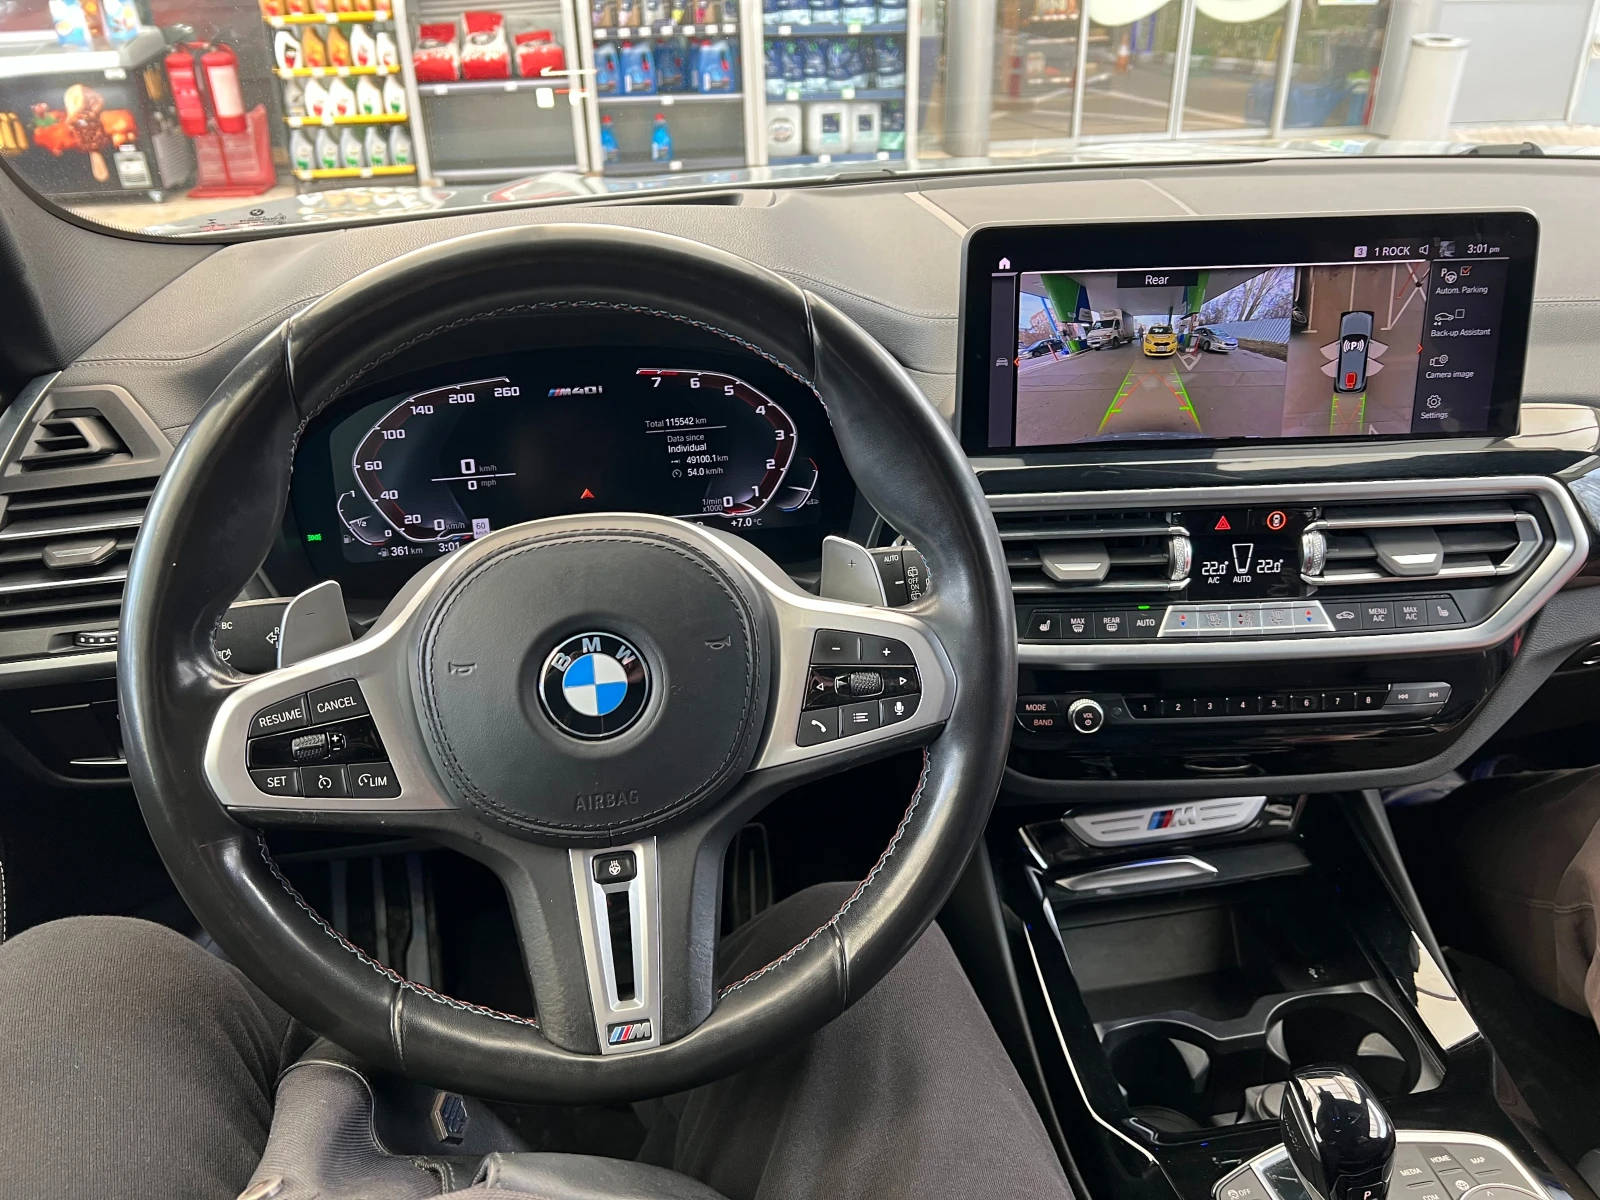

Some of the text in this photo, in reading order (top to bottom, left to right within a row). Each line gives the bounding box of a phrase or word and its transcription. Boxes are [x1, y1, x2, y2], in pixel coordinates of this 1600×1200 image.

[1358, 248, 1364, 256] 3
[1382, 246, 1410, 256] ROCK
[1467, 244, 1488, 254] 3:01
[1145, 275, 1170, 285] Rear
[1435, 286, 1488, 295] Autom. Parking
[1430, 328, 1491, 338] Back-up Assistant
[1452, 370, 1474, 378] image
[651, 377, 662, 388] 7
[690, 378, 700, 389] 6
[494, 386, 520, 398] 260
[559, 385, 602, 396] M40i
[724, 385, 734, 396] 5
[448, 393, 476, 404] 200
[410, 405, 434, 416] 140
[755, 405, 766, 416] 4
[1420, 412, 1448, 420] Settings
[645, 420, 664, 428] Total
[665, 416, 694, 426] 115542
[382, 429, 406, 440] 100
[667, 434, 704, 443] Data since
[774, 430, 785, 440] 3
[668, 442, 707, 454] Individual
[686, 454, 716, 464] 49100.1
[364, 460, 382, 471] 60
[460, 458, 476, 474] 0
[766, 459, 776, 470] 2
[688, 467, 724, 476] 54.0 km/h
[468, 480, 497, 490] 0 mph
[380, 490, 398, 500] 40
[752, 486, 760, 497] 1
[702, 498, 722, 506] 1/min
[722, 496, 734, 508] 0
[702, 504, 723, 512] x1000
[404, 514, 422, 524] 20
[434, 518, 466, 530] 0 km/h
[730, 517, 752, 528] +7.0
[476, 522, 486, 530] 60
[384, 529, 392, 537] 0
[390, 546, 423, 556] 361 km
[438, 542, 460, 552] 3:01
[884, 554, 899, 563] AUTO
[1372, 614, 1386, 622] A/C
[1404, 612, 1418, 620] A/C
[222, 622, 233, 630] BC
[551, 636, 636, 673] BMW
[316, 696, 357, 714] CANCEL
[258, 708, 302, 728] RESUME
[1033, 718, 1053, 726] BAND
[266, 776, 287, 788] SET
[370, 776, 388, 788] LIM
[574, 789, 640, 812] AIRBAG
[1430, 1154, 1452, 1164] HOME
[1470, 1156, 1486, 1164] MAP
[1400, 1168, 1422, 1176] MEDIA
[1238, 1189, 1250, 1197] OFF
[1364, 1190, 1372, 1200] P
